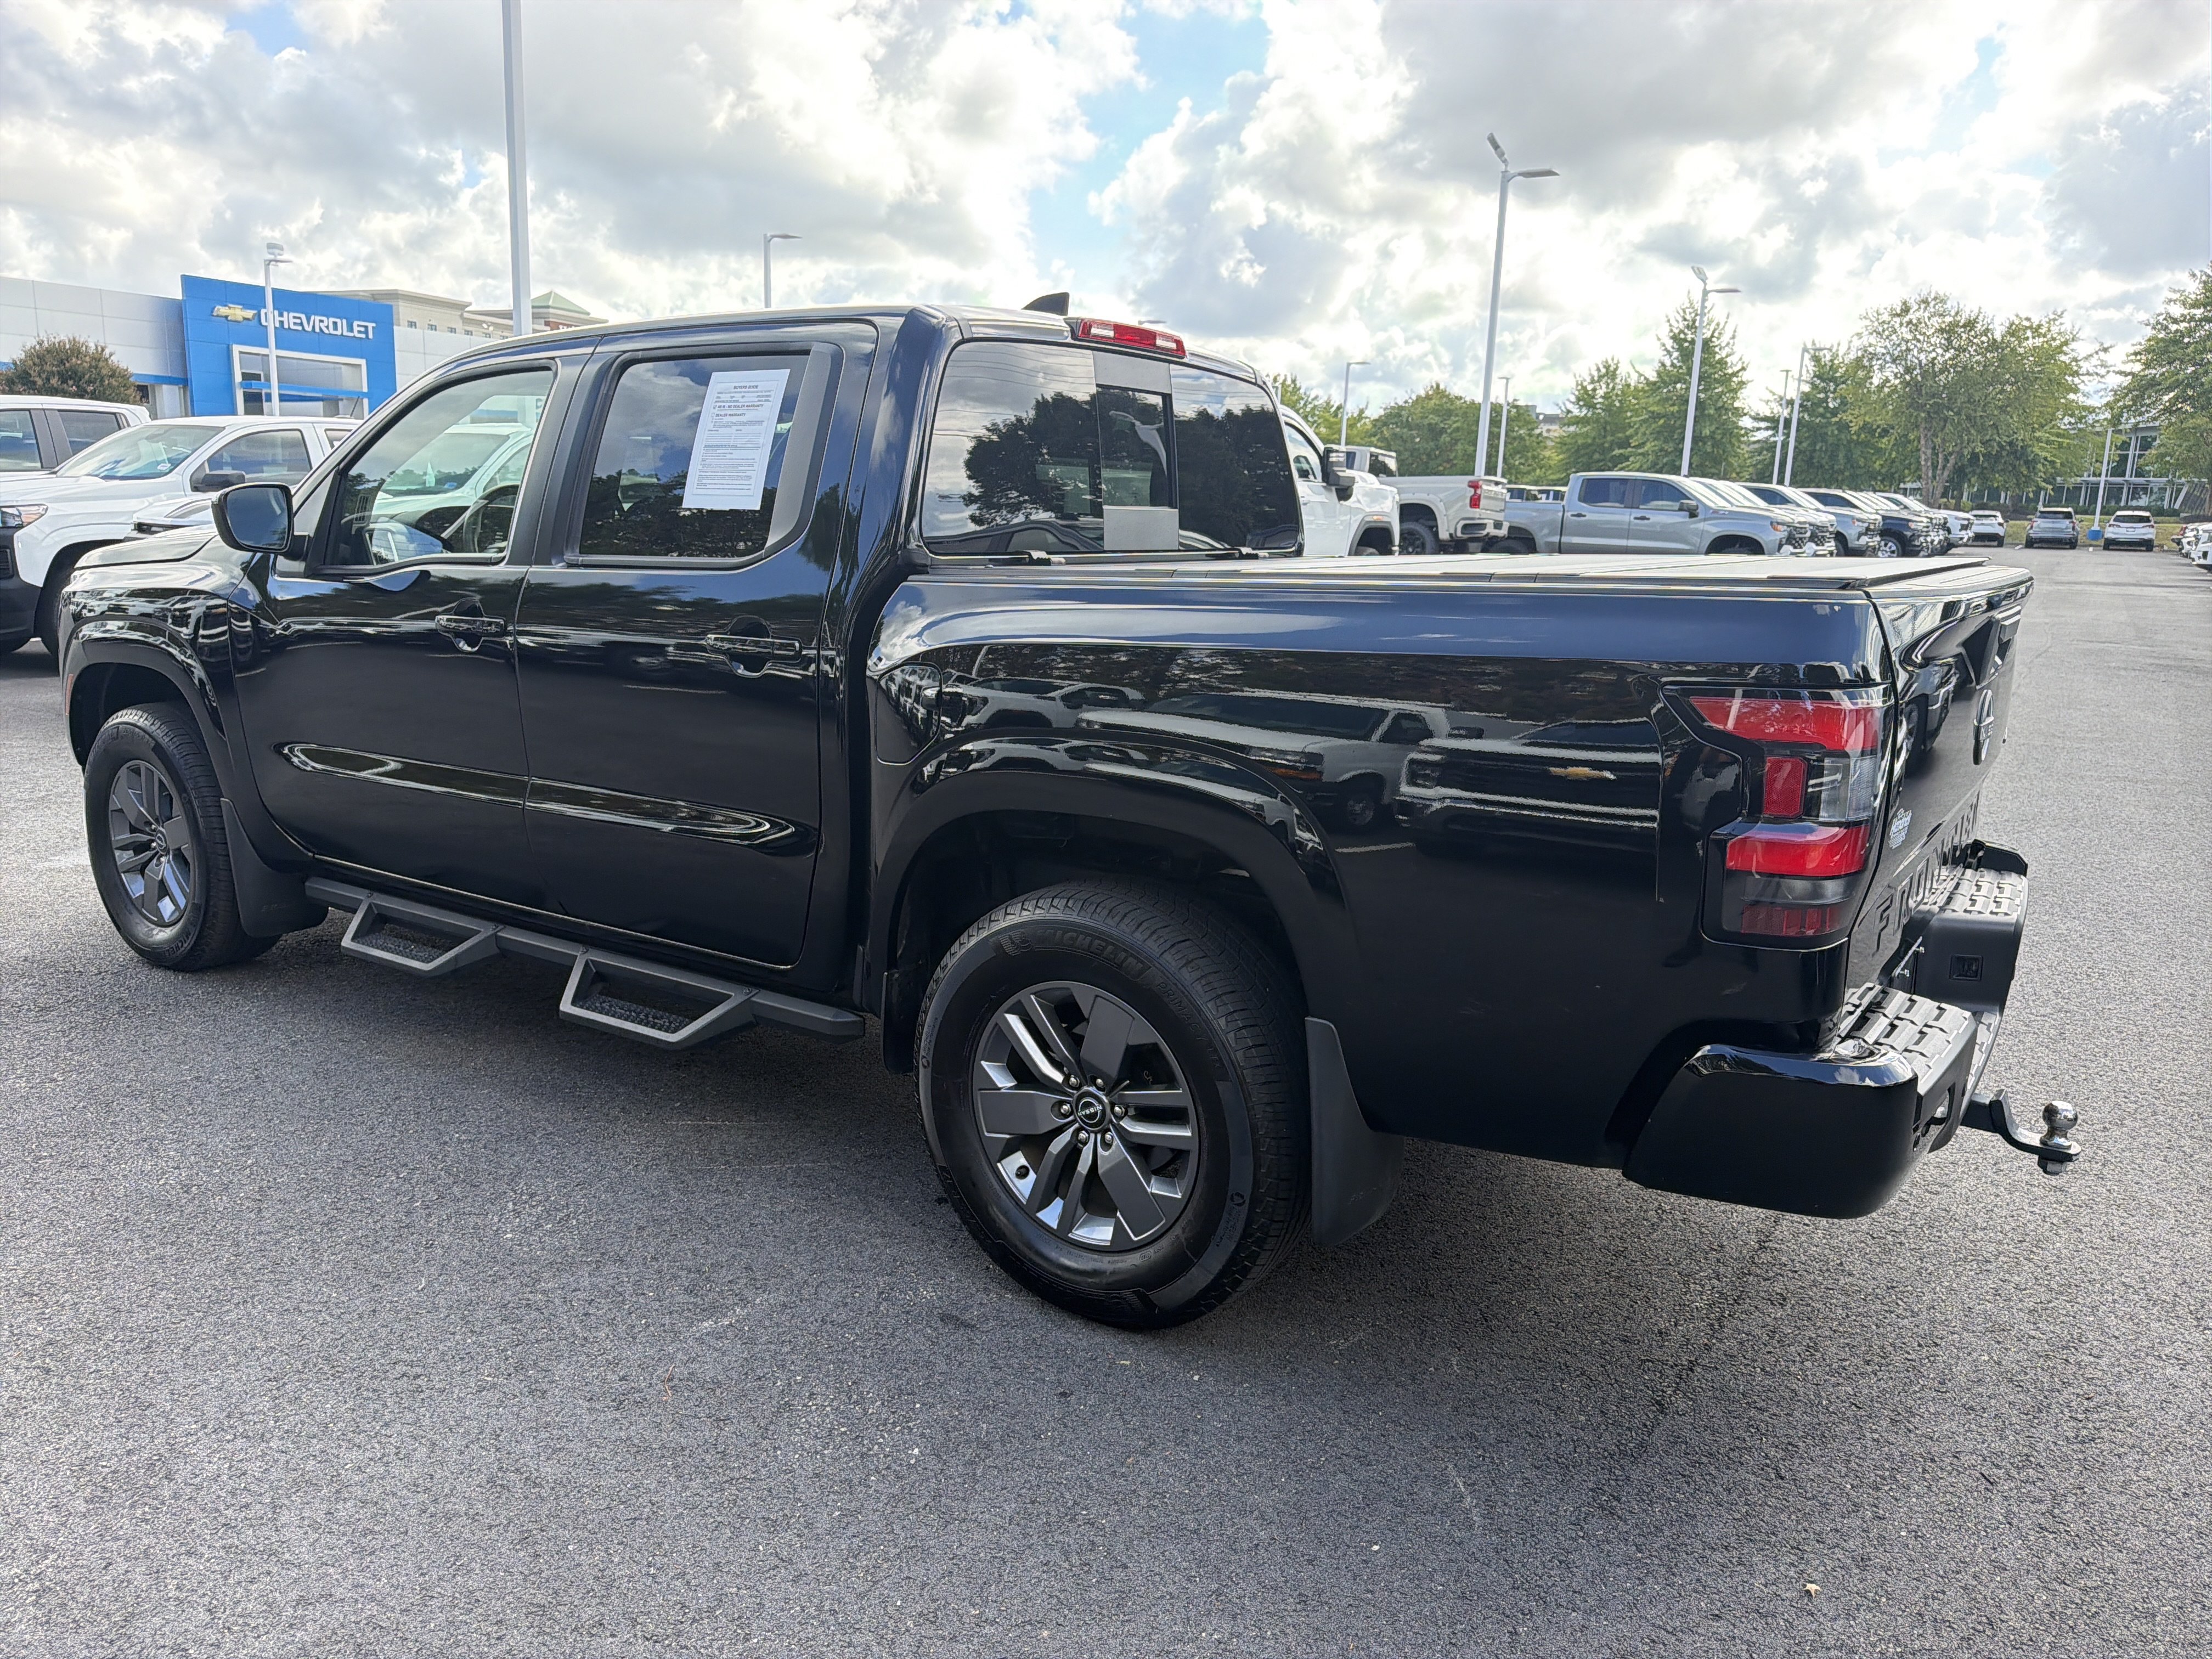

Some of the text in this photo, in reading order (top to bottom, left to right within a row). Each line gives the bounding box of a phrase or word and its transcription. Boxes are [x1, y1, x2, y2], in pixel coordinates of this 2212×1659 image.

[261, 308, 376, 339] CHEVROLET
[1036, 928, 1144, 975] MICHELIN
[1156, 981, 1209, 1042] PRIMACY
[1077, 1104, 1102, 1116] NISSAN
